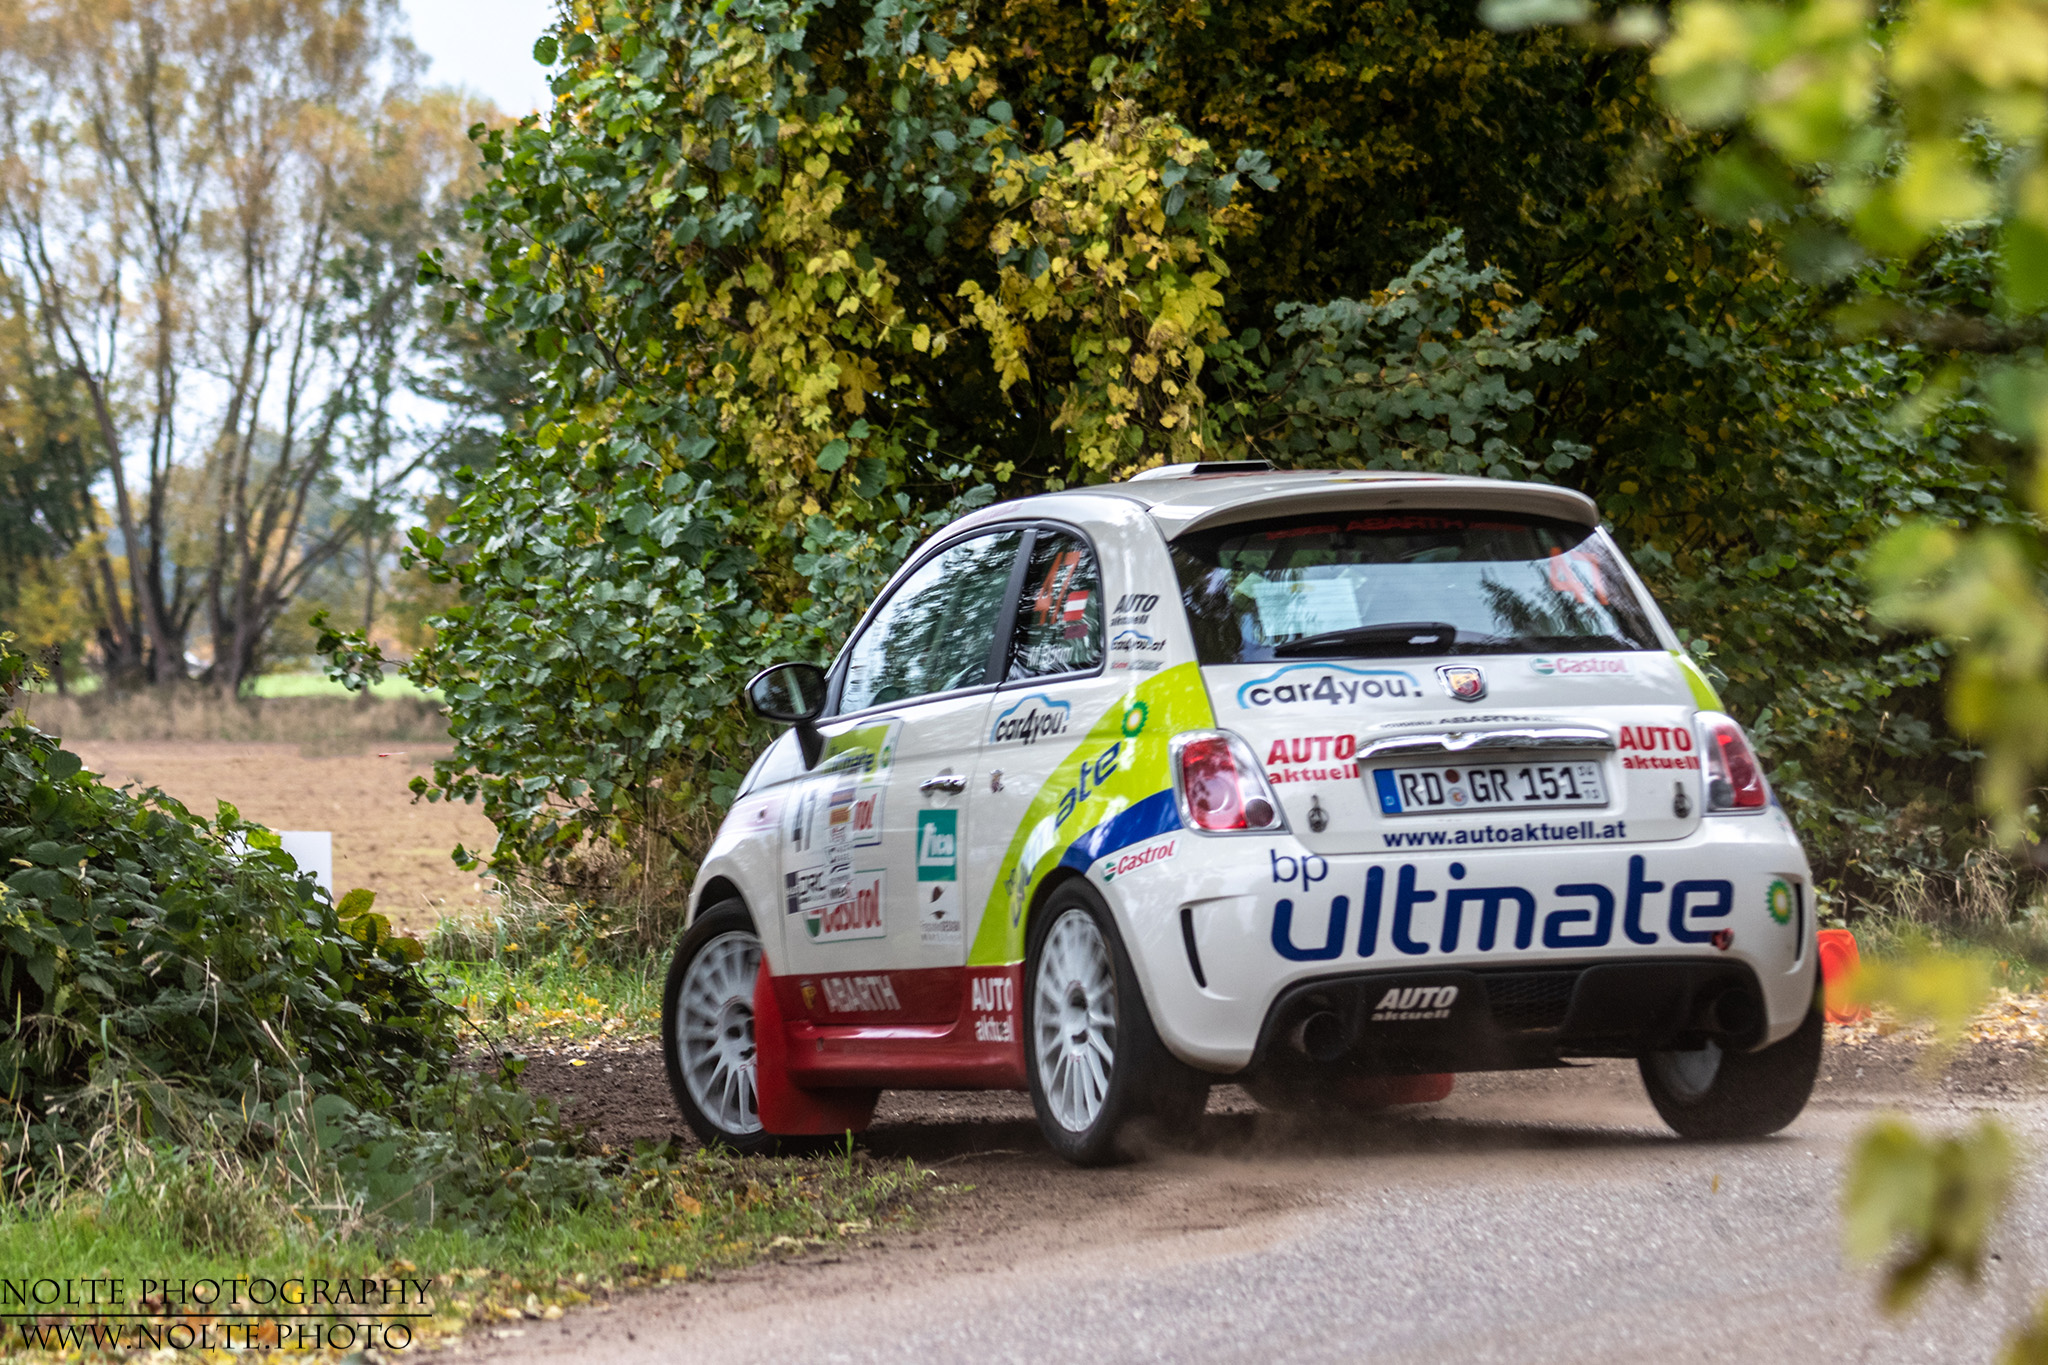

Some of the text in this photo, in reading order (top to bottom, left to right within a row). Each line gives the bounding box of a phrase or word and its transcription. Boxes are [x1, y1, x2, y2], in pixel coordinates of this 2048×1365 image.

[1112, 593, 1160, 615] AUTO
[1556, 657, 1629, 674] Castrol
[1250, 675, 1424, 706] car4you.
[1266, 734, 1357, 766] AUTO
[1619, 725, 1692, 751] AUTO
[1269, 763, 1360, 785] aktuell
[1622, 754, 1700, 770] aktuell
[1400, 772, 1446, 807] RD
[1467, 769, 1514, 803] GR
[1518, 766, 1582, 801] 151
[1383, 821, 1627, 847] www.autoaktuell.at
[1117, 840, 1175, 877] Castrol
[1269, 848, 1329, 892] bp
[1270, 854, 1734, 962] ultimate
[820, 974, 902, 1012] ABARTH
[971, 976, 1014, 1012] AUTO
[1374, 985, 1459, 1010] AUTO
